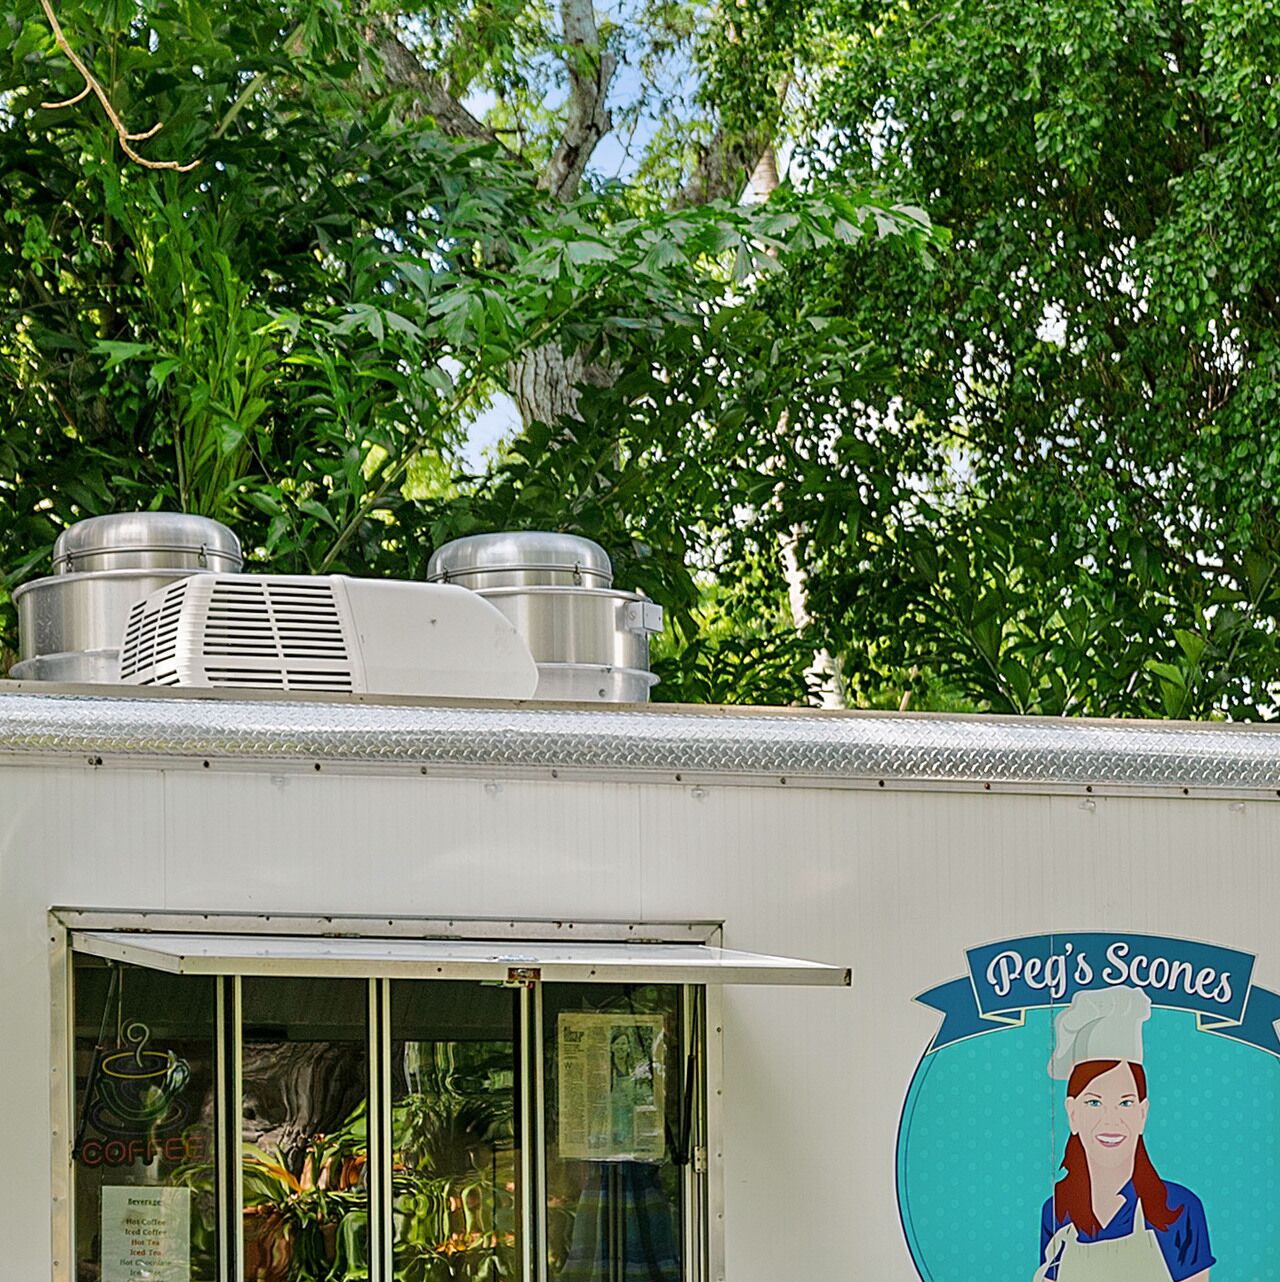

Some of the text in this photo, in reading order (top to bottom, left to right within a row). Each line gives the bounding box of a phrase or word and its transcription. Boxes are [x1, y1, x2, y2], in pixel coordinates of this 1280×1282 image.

[986, 941, 1234, 1004] Peg's Scones
[82, 1135, 206, 1165] COFFEE
[141, 1218, 166, 1226] Coffee
[142, 1228, 167, 1236] Coffee
